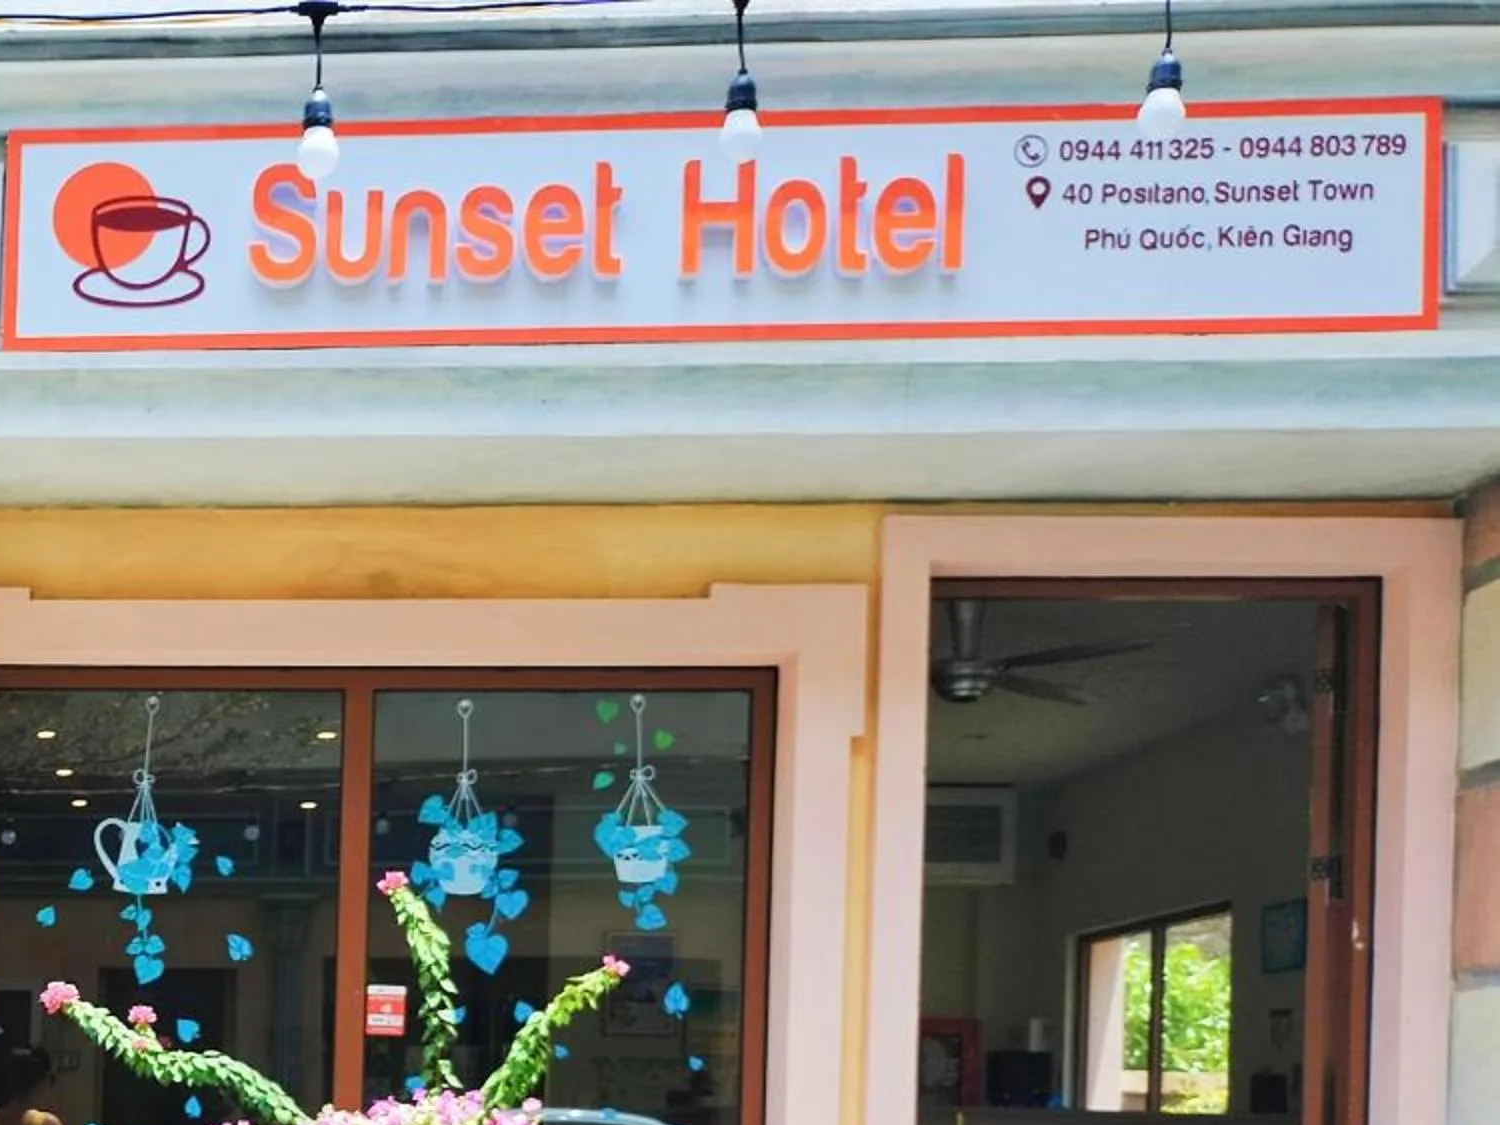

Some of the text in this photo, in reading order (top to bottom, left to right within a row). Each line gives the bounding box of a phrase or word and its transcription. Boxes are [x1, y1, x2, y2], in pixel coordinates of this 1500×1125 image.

[1059, 138, 1122, 161] 0944
[1238, 136, 1302, 159] 0944
[1309, 134, 1356, 157] 803
[1362, 133, 1407, 156] 789
[1061, 183, 1093, 205] 40
[1213, 179, 1300, 204] Sunset
[1307, 179, 1374, 201] Town
[249, 153, 965, 286] Sunset Hotel
[1084, 226, 1131, 250] Phú
[1217, 223, 1274, 248] Kiên
[1283, 222, 1354, 253] Giang
